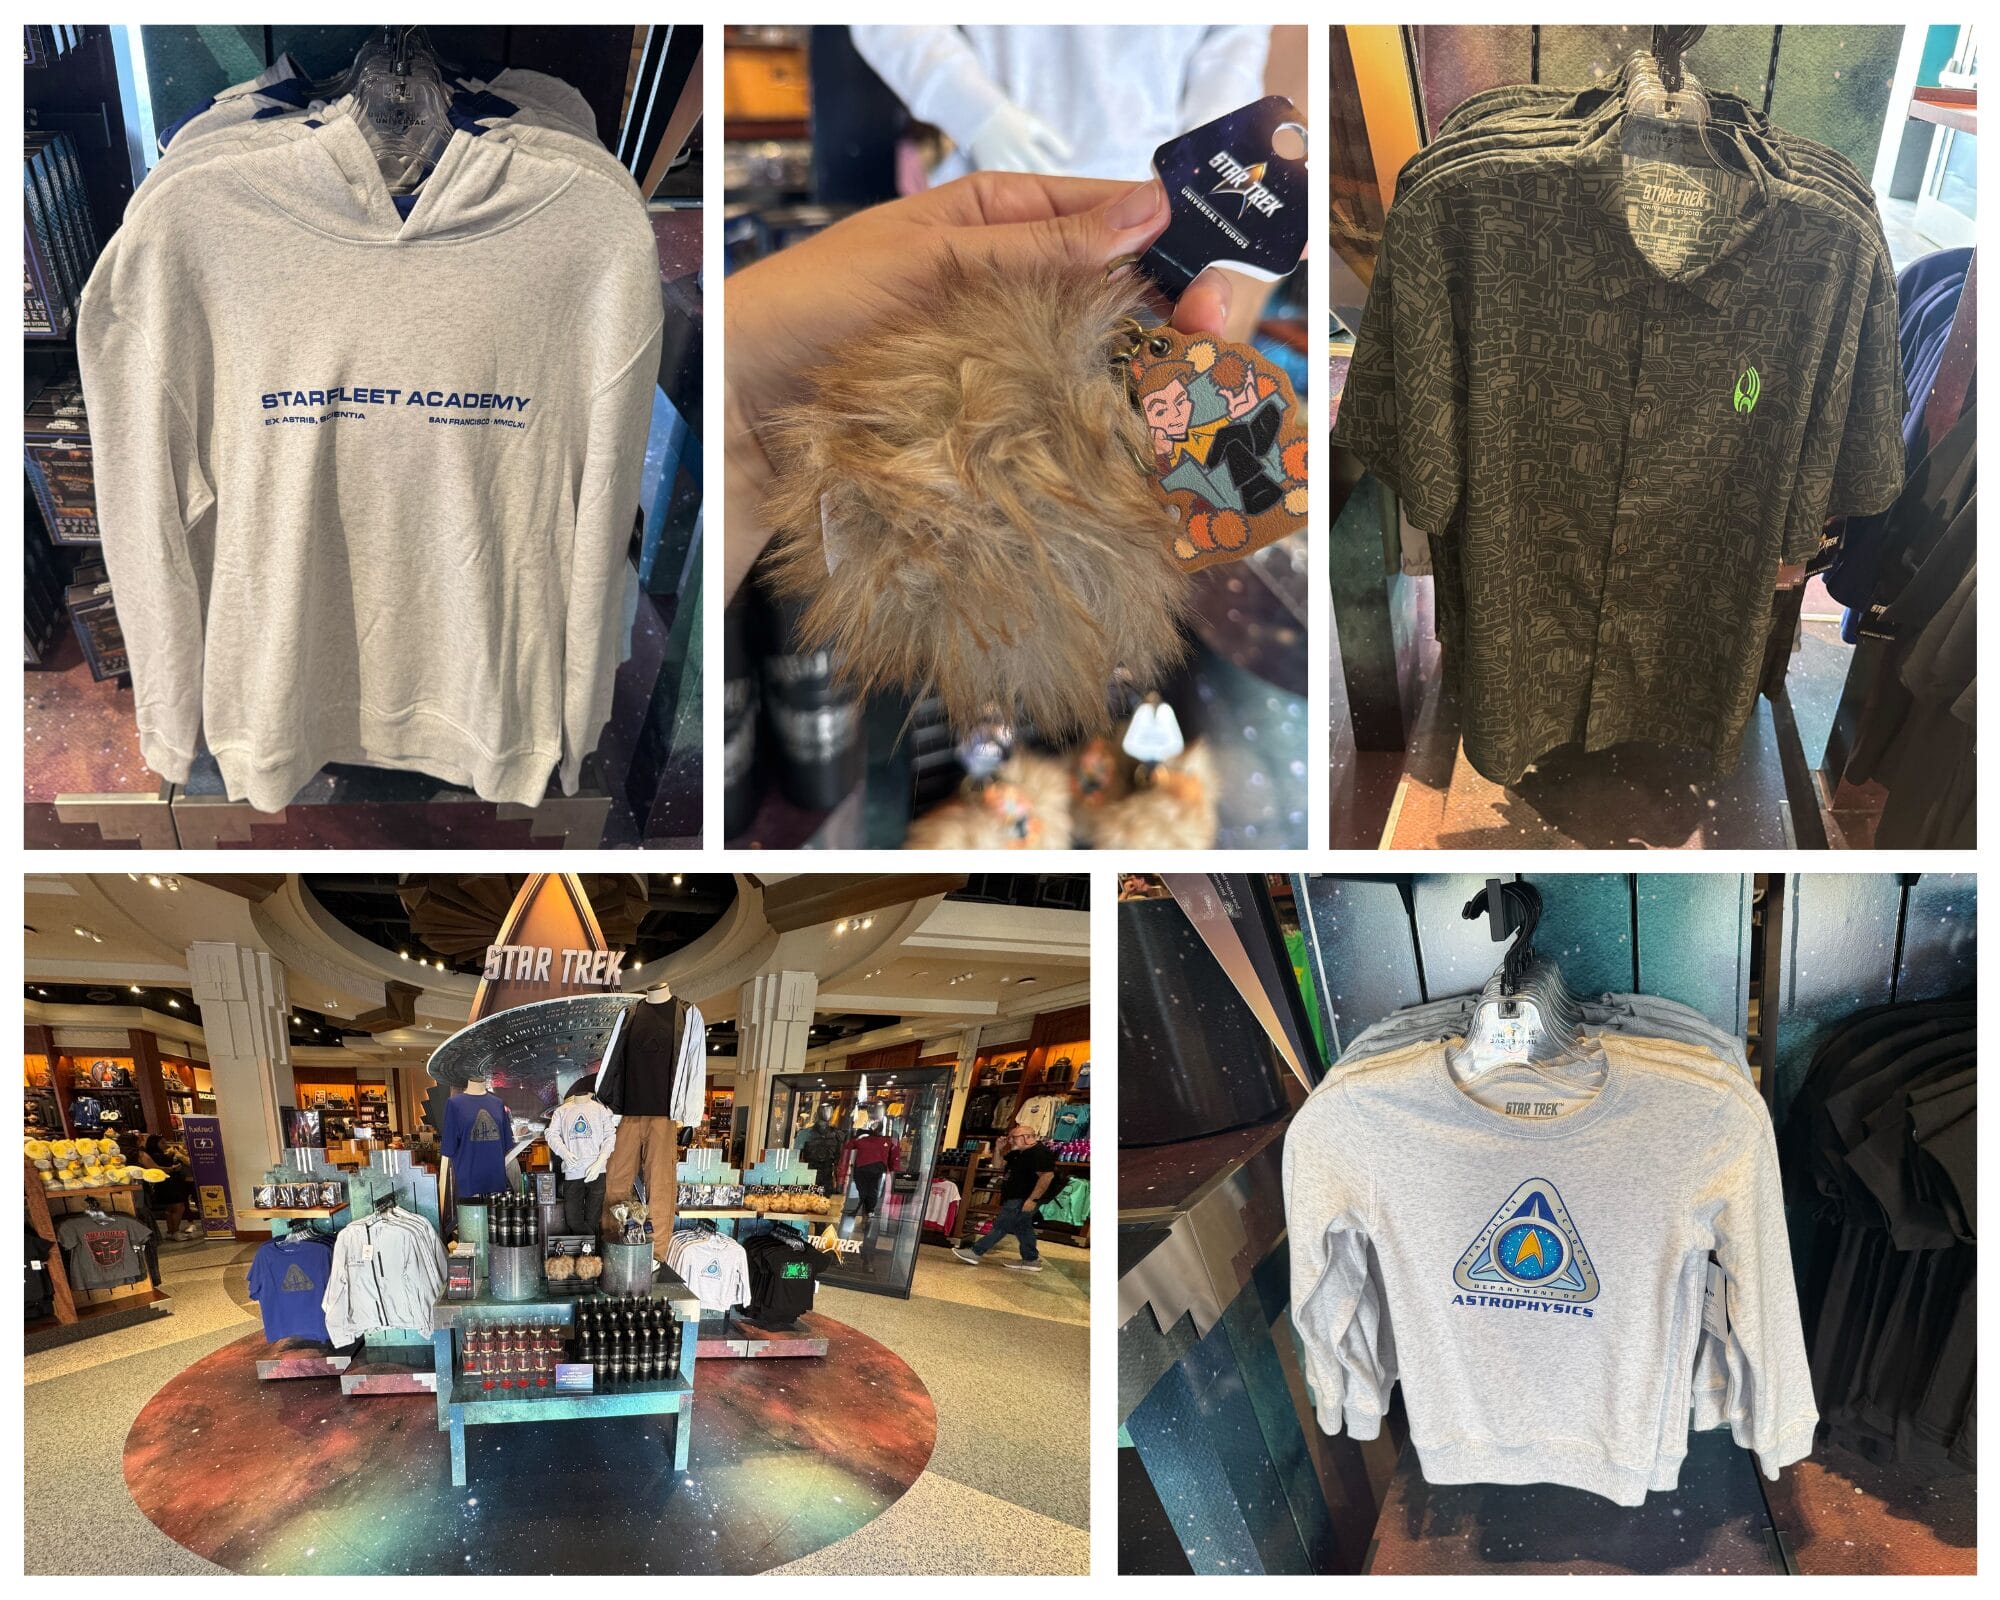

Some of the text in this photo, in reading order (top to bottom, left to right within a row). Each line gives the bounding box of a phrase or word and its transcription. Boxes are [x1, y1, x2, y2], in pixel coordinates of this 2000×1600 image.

[1670, 76, 1676, 85] S
[1208, 151, 1285, 218] STAR TREK
[1643, 184, 1706, 208] STAR TREK
[1181, 187, 1249, 250] UNIVERSAL STUDIOS
[261, 387, 531, 412] STARFLEET ACADEMY
[265, 418, 279, 426] EX
[320, 411, 366, 423] SCIENTIA
[428, 416, 448, 424] SAN
[448, 418, 490, 426] FRANCISCO
[484, 944, 627, 986] STAR TREK
[1505, 1101, 1531, 1115] STAR
[1462, 1200, 1517, 1266] STARFLEET
[1557, 1208, 1592, 1275] ACADEMY
[832, 1238, 863, 1253] TREK
[1474, 1284, 1555, 1297] DEPARTMENT
[1451, 1294, 1594, 1318] ASTROPHYSICS
